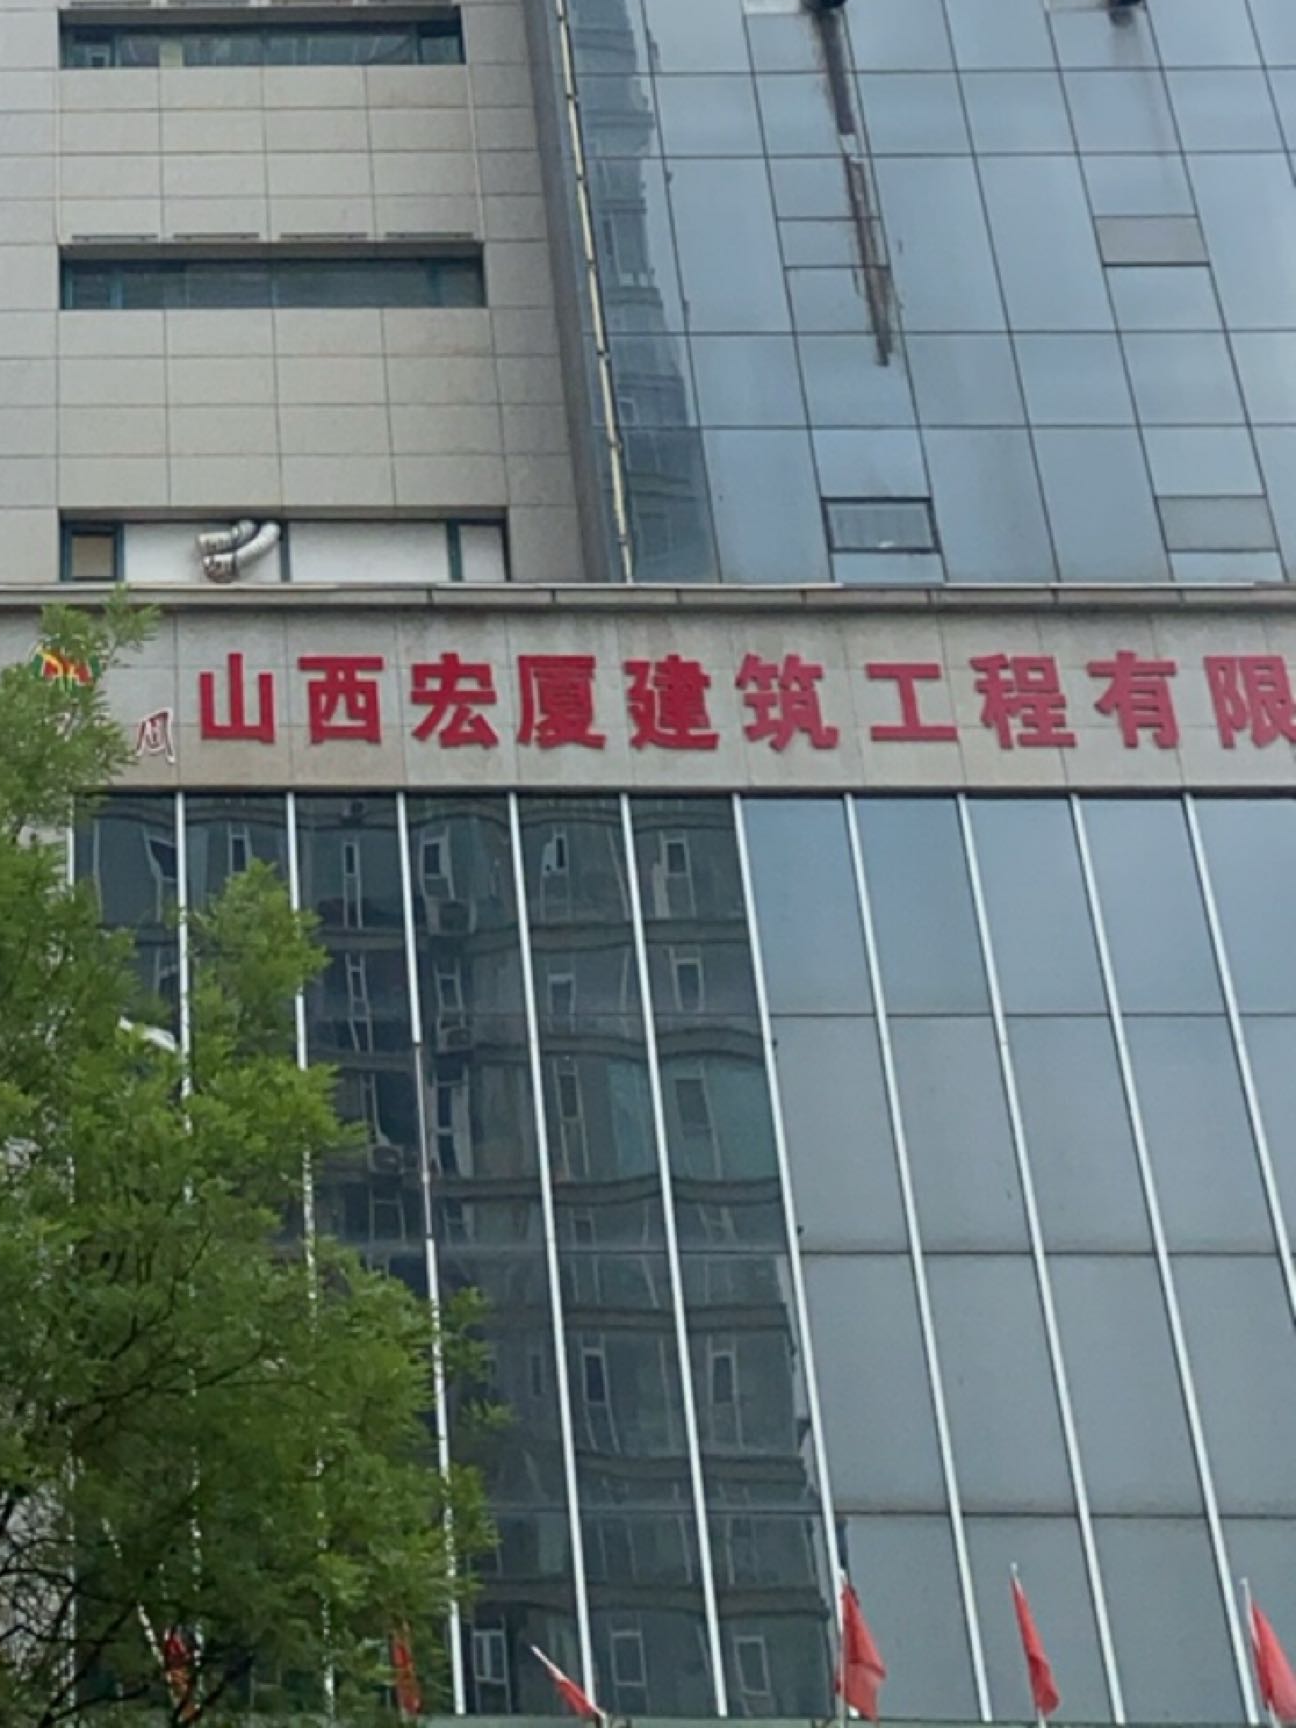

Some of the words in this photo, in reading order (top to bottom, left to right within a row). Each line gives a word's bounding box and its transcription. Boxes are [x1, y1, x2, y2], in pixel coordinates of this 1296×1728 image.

[198, 651, 1296, 751] 山西宏厦建筑工程有限
